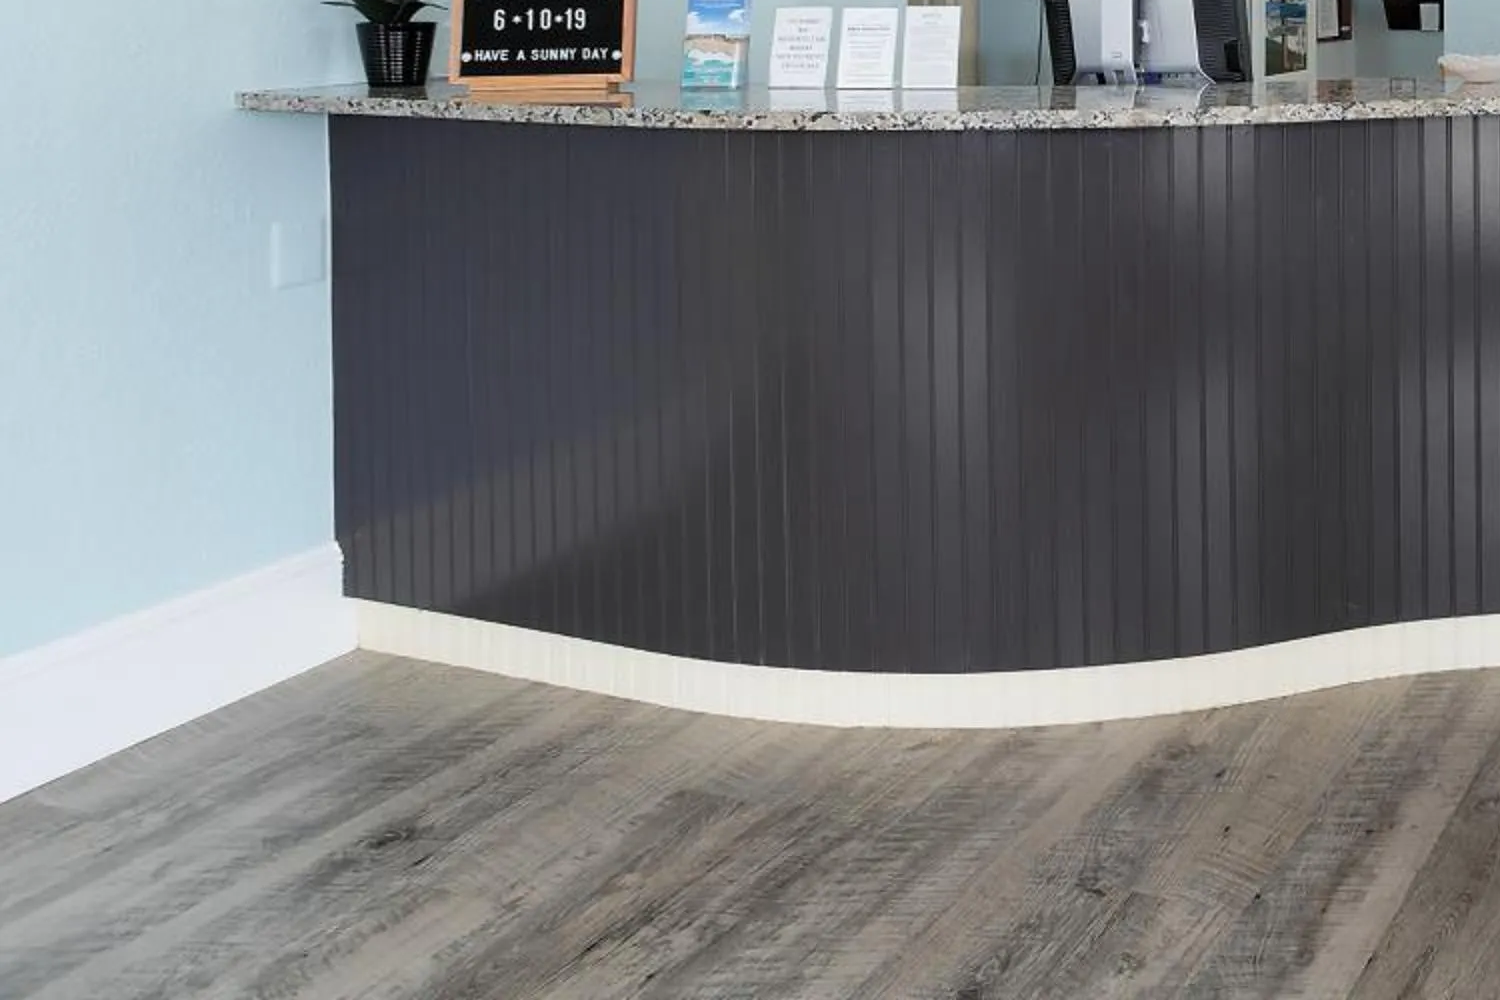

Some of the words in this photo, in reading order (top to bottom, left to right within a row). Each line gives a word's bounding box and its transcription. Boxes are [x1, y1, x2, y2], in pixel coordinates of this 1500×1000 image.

[474, 50, 510, 62] HAVE
[516, 50, 527, 61] A
[530, 48, 577, 61] SUNNY
[581, 48, 609, 61] DAY
